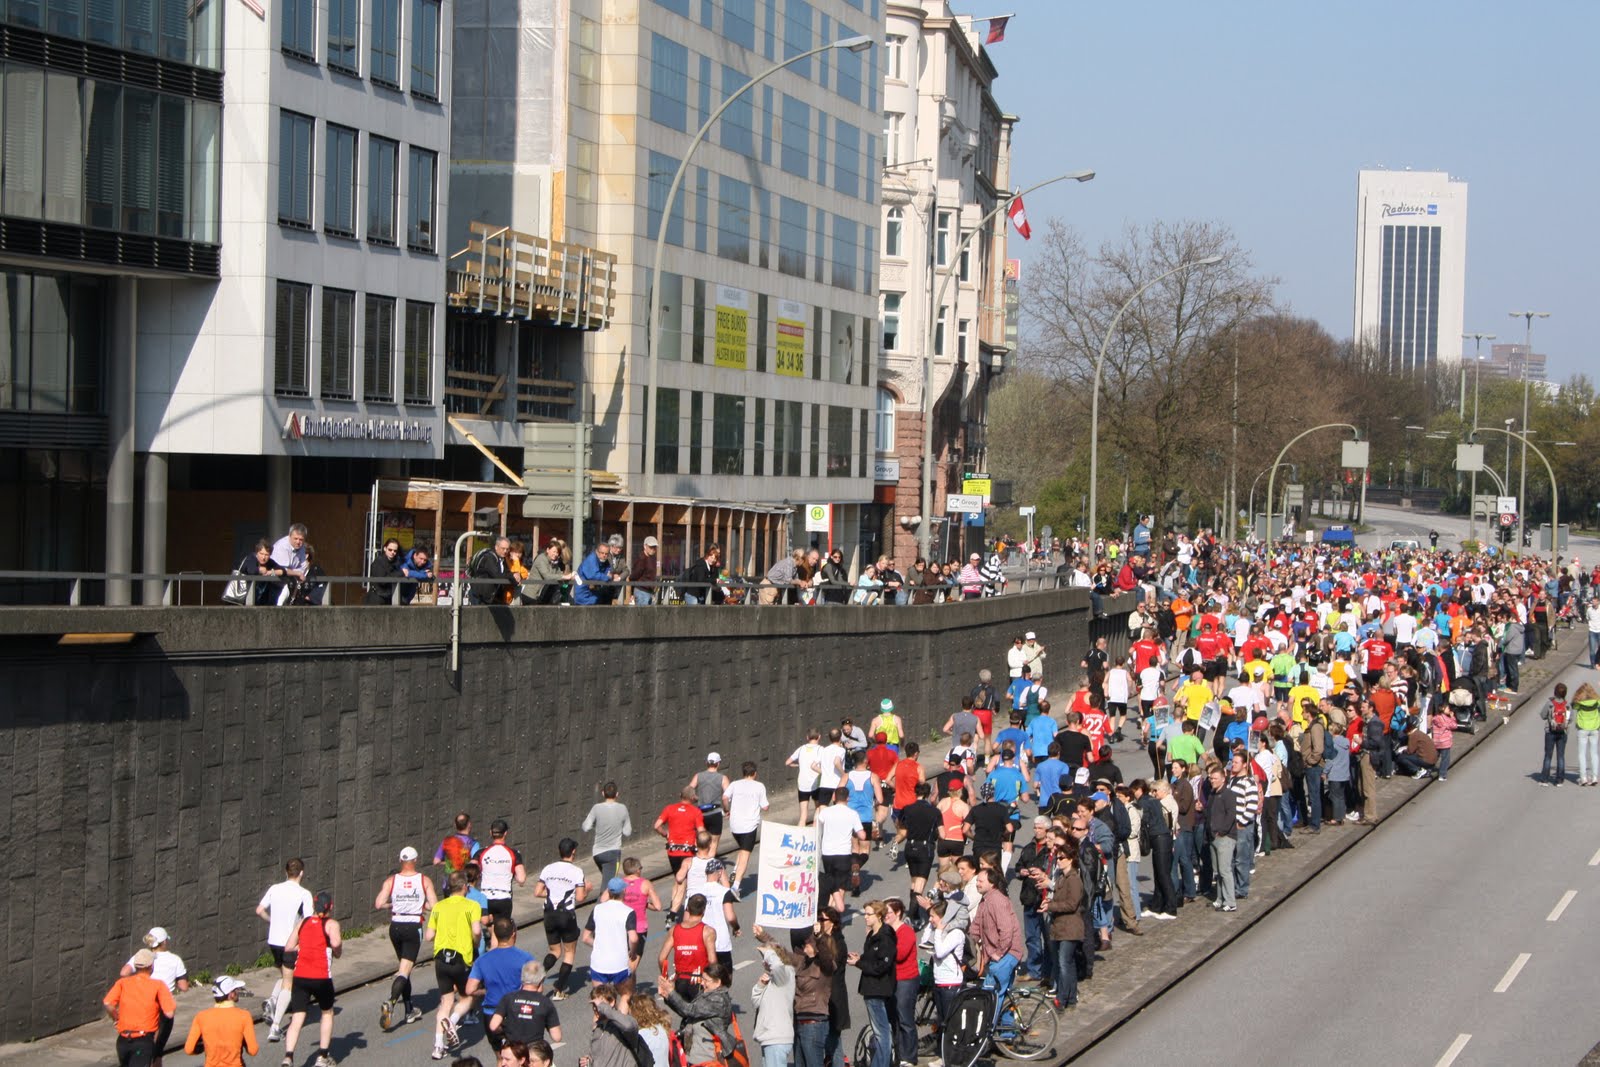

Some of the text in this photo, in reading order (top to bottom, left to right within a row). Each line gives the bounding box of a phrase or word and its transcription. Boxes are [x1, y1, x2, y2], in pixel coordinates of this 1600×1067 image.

[1382, 202, 1426, 218] Radisson
[777, 350, 803, 372] 34 34 36
[874, 465, 893, 474] Group
[1085, 718, 1103, 735] 22
[773, 874, 796, 892] die
